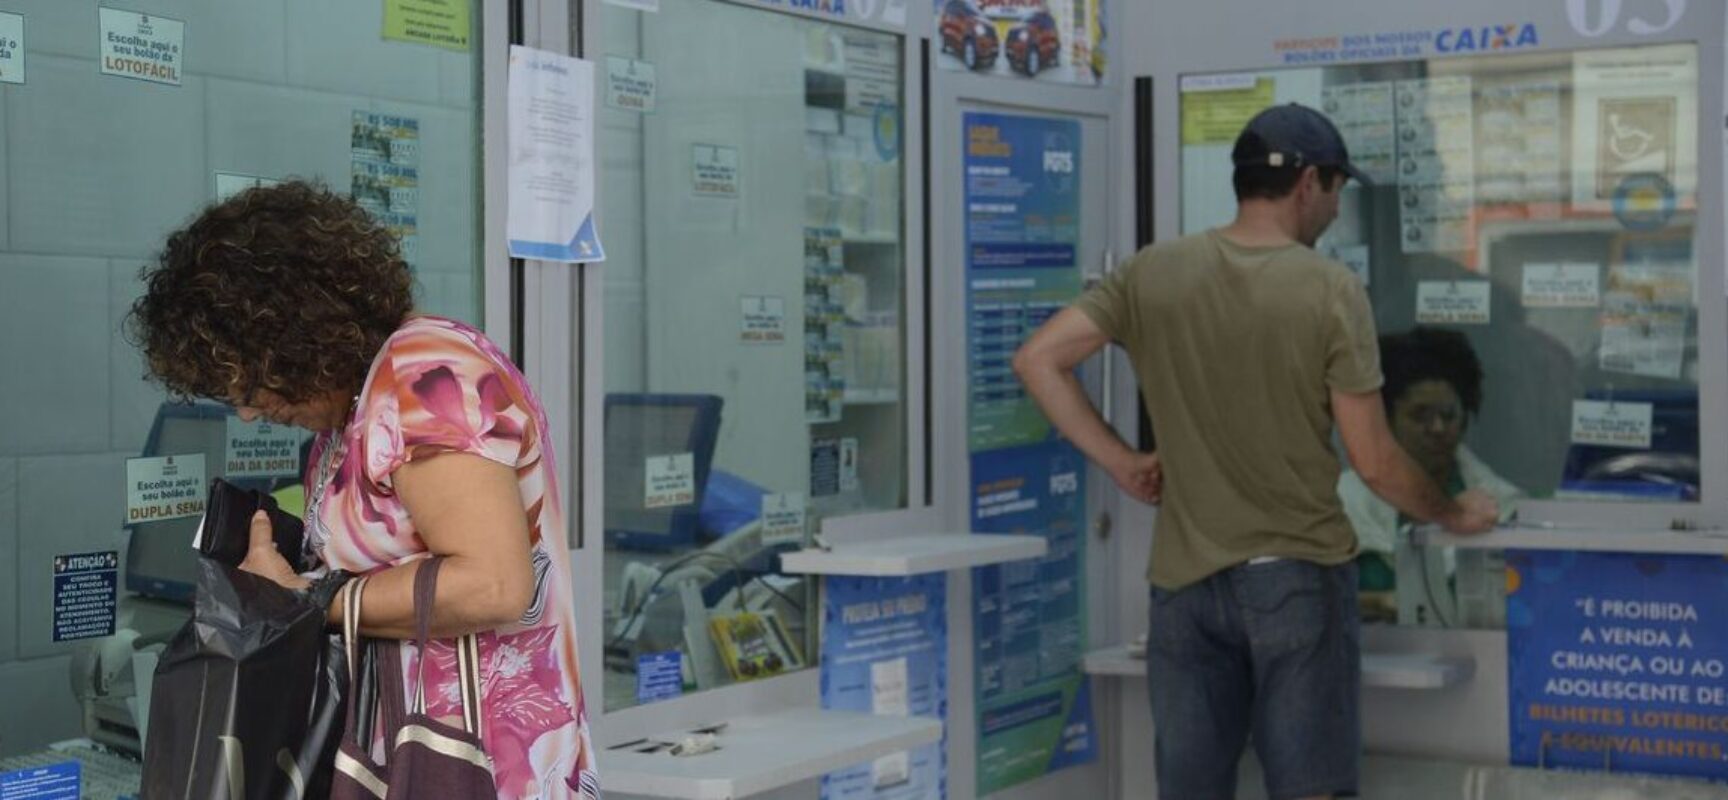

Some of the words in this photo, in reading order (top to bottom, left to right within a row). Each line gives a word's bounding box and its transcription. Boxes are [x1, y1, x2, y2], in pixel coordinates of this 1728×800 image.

[107, 31, 148, 48] Escolha
[151, 41, 170, 53] aqui
[1435, 23, 1539, 53] CAIXA
[113, 45, 132, 55] seu
[162, 52, 173, 62] da
[228, 460, 246, 472] DIA
[248, 460, 262, 471] DA
[137, 480, 173, 491] Escolha
[175, 478, 193, 488] aqui
[142, 493, 159, 502] seu
[186, 488, 196, 497] da
[130, 505, 173, 520] DUPLA
[176, 500, 204, 515] SENA
[68, 553, 105, 570] ATENÇÃO
[1601, 600, 1697, 621] PROIBIDA
[1579, 627, 1596, 643] A
[1600, 627, 1671, 647] VENDA
[1552, 651, 1643, 675] CRIANÇA
[1650, 656, 1684, 675] OU
[1690, 660, 1724, 677] AO
[1545, 679, 1689, 704] ADOLESCENTE
[1530, 704, 1625, 727] BILHETES
